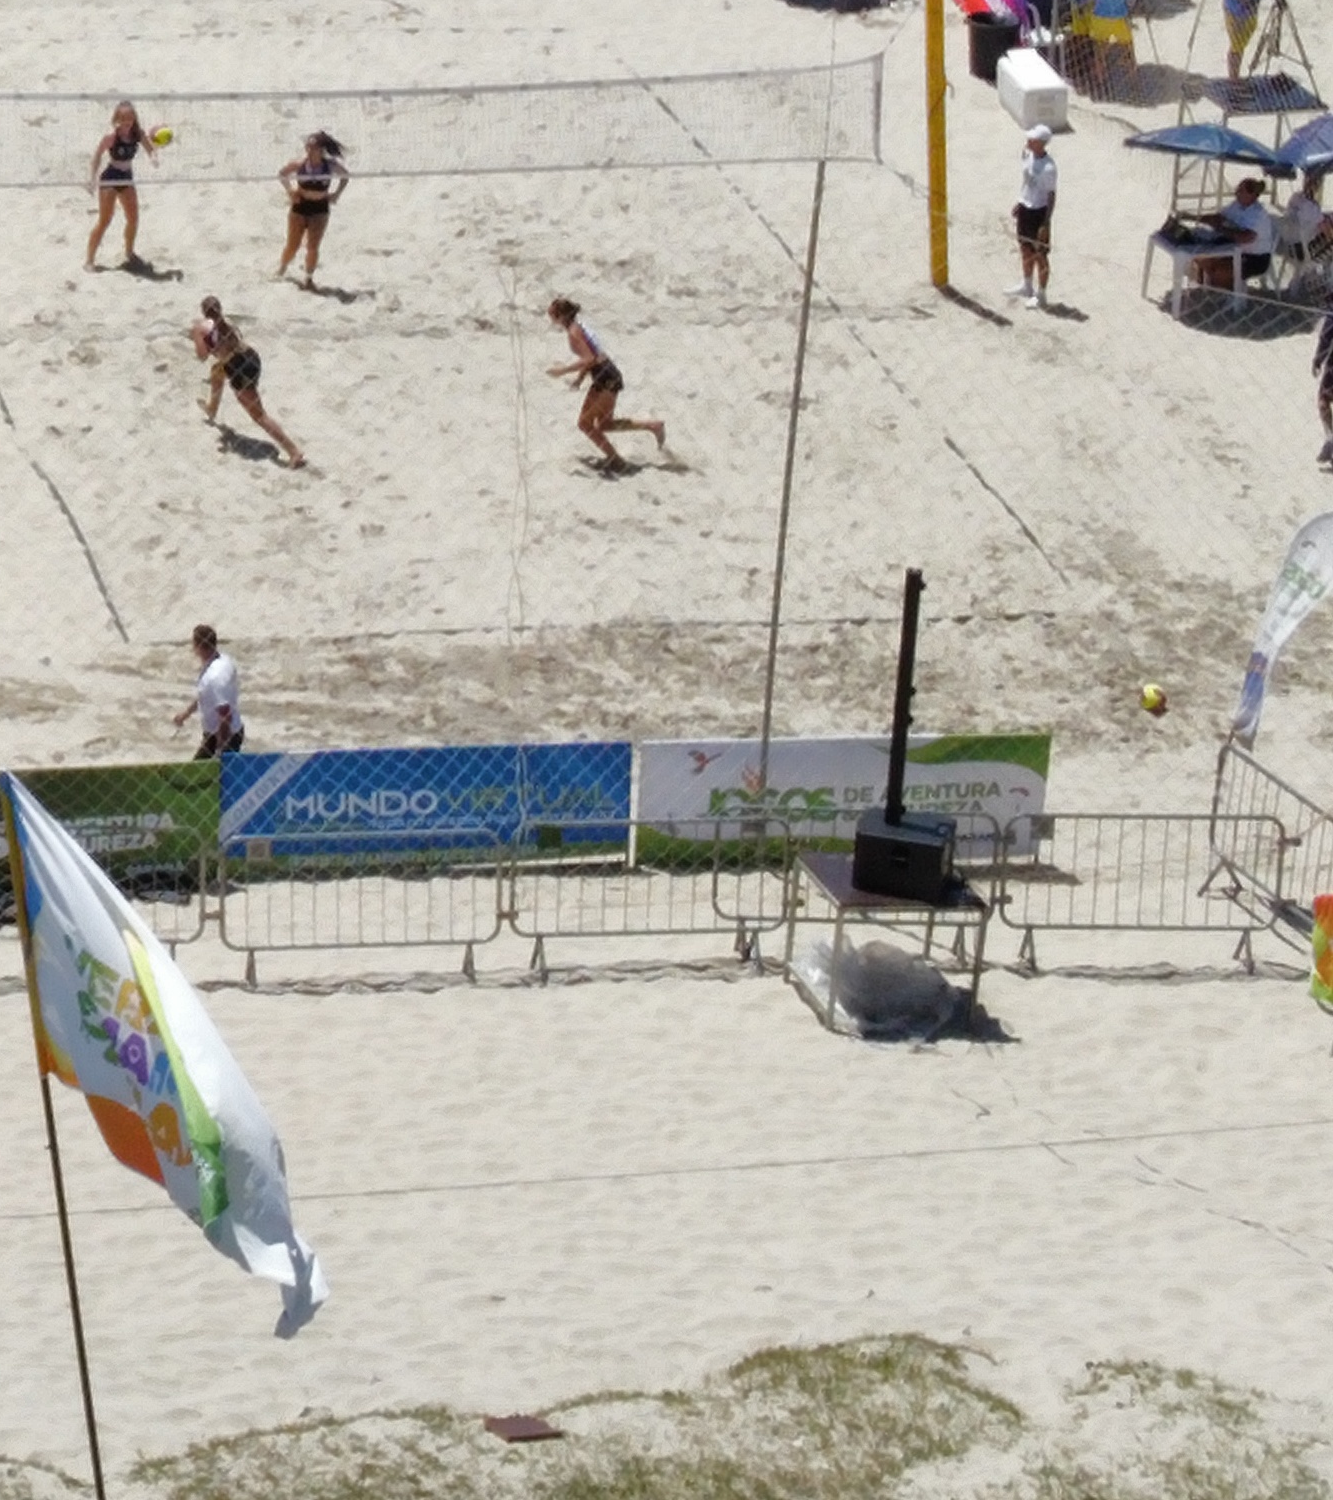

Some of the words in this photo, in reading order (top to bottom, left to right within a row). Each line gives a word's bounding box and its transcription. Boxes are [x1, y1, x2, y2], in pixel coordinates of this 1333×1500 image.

[286, 790, 438, 820] MUNDO
[843, 787, 873, 804] DE
[882, 781, 1000, 803] VENTURA
